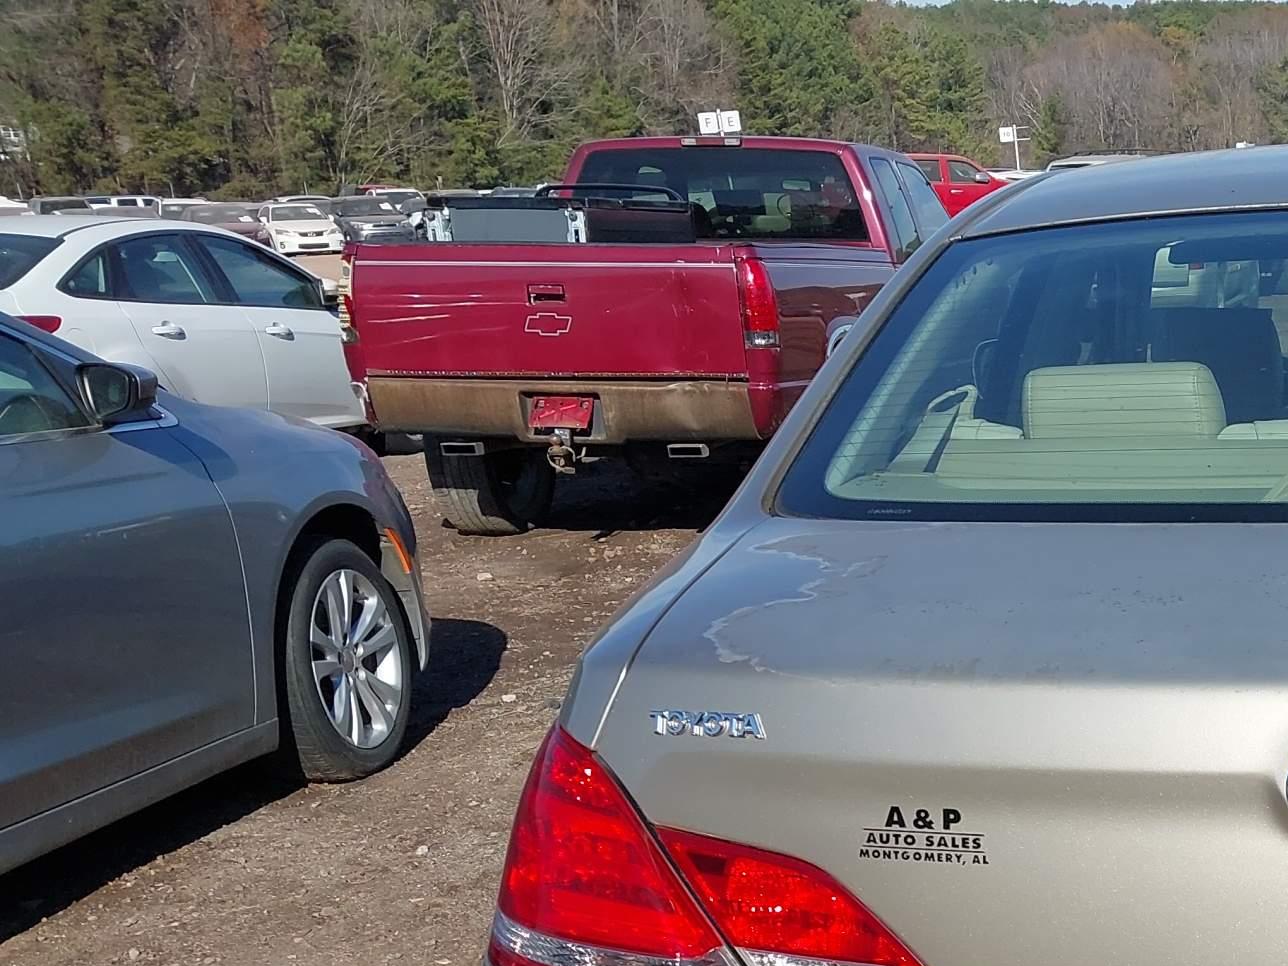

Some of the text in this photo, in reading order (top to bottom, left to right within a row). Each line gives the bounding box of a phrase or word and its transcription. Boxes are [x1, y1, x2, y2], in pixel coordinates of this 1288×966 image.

[704, 117, 712, 128] F
[727, 116, 735, 127] E
[649, 709, 767, 740] TOYOTA
[885, 806, 961, 830] A & P
[866, 832, 982, 850] AUTO SALES
[859, 848, 989, 866] MONTGOMERY, AL
